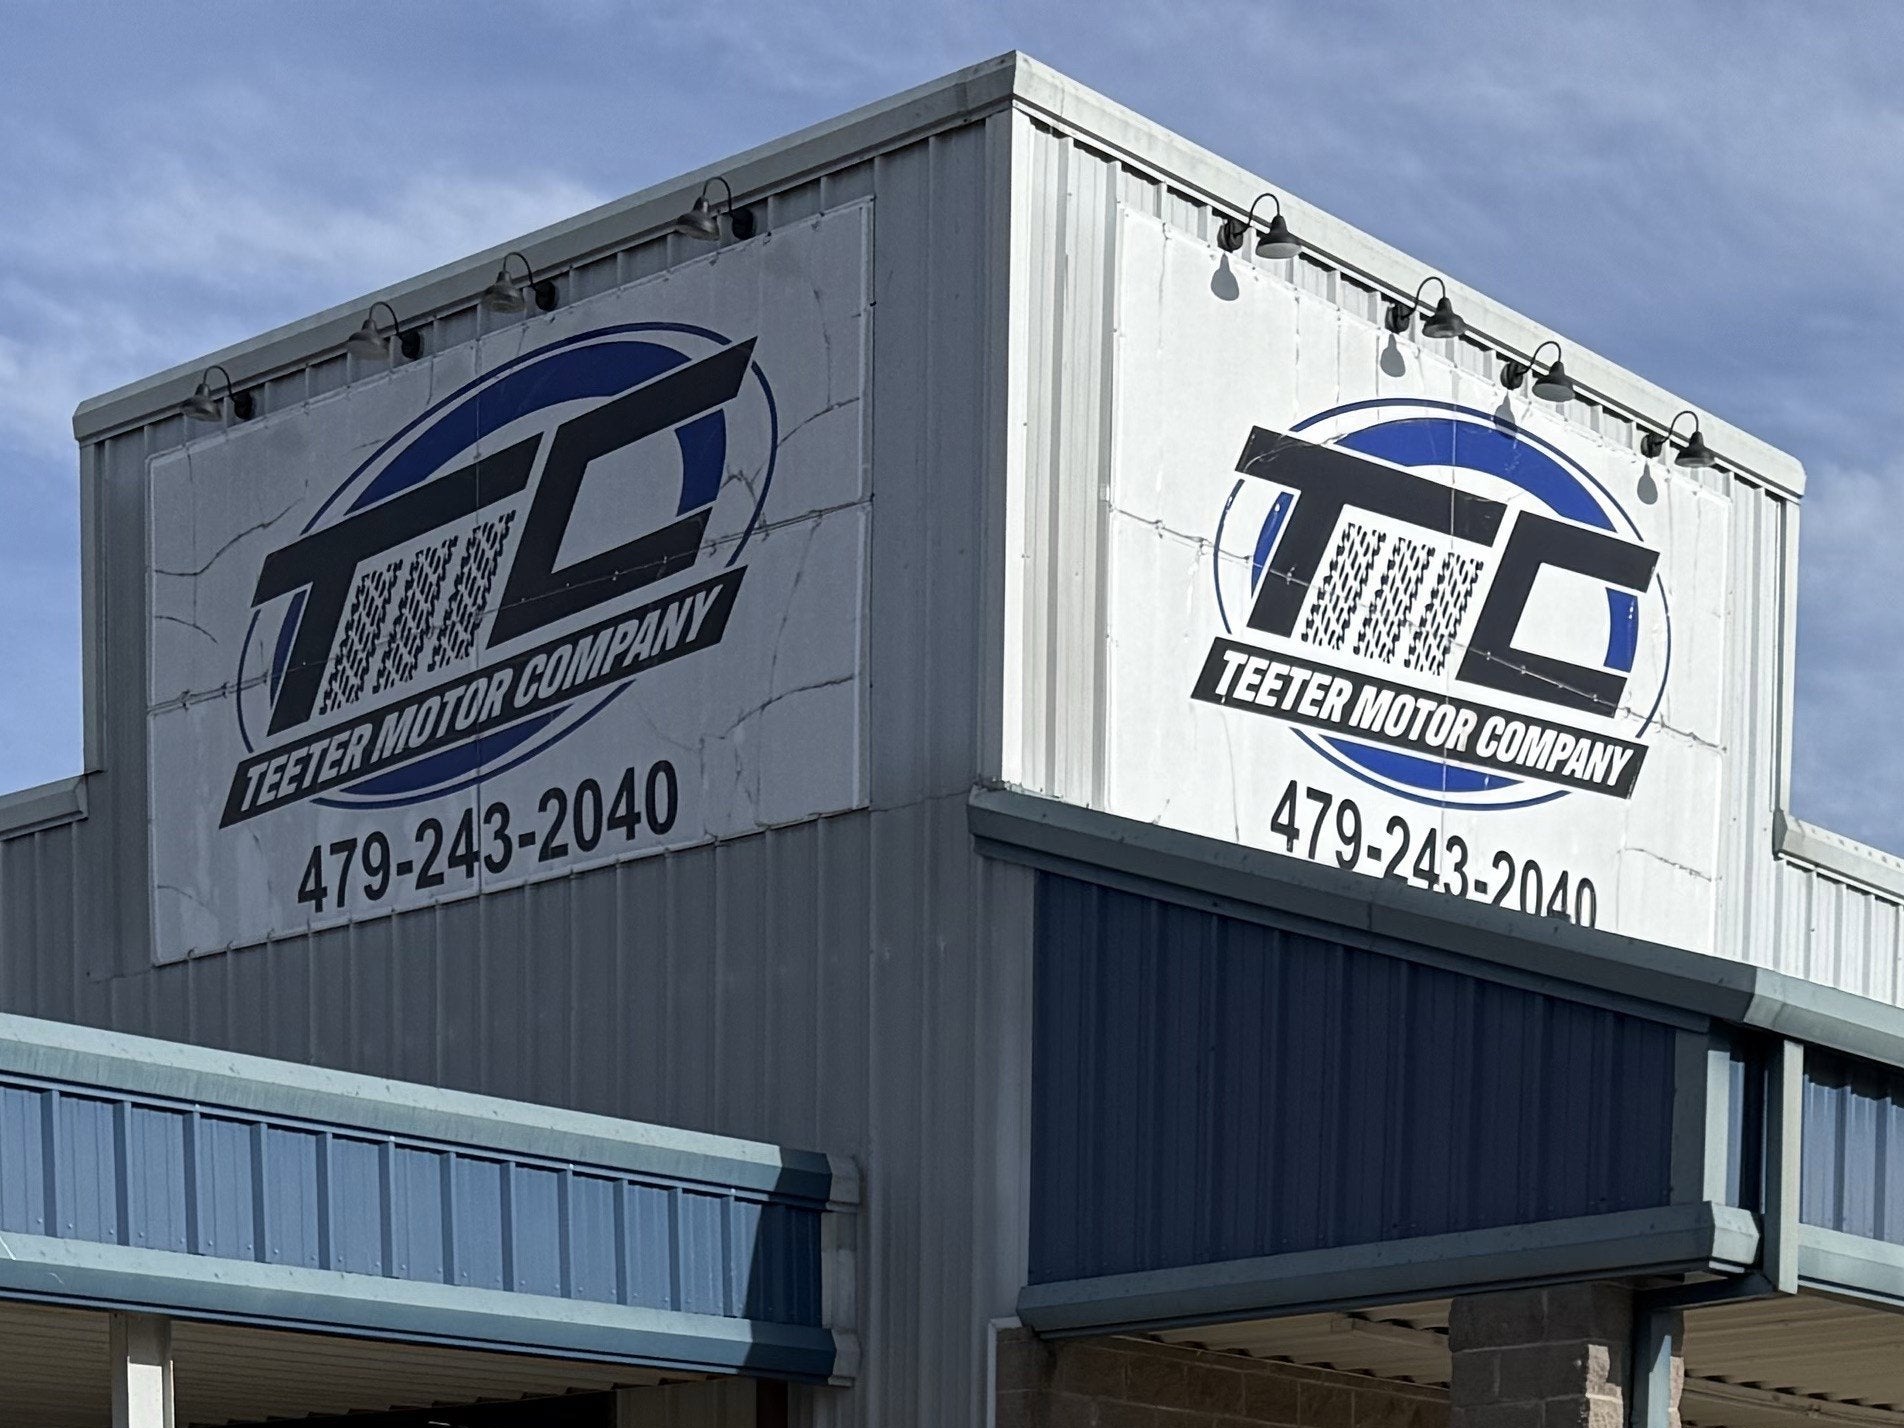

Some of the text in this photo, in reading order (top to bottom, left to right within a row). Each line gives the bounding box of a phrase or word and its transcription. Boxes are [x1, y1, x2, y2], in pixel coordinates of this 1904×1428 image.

[239, 583, 724, 812] TEETER MOTOR COMPANY
[1213, 649, 1635, 787] TEETER MOTOR COMPANY
[297, 759, 679, 913] 479-243-2040
